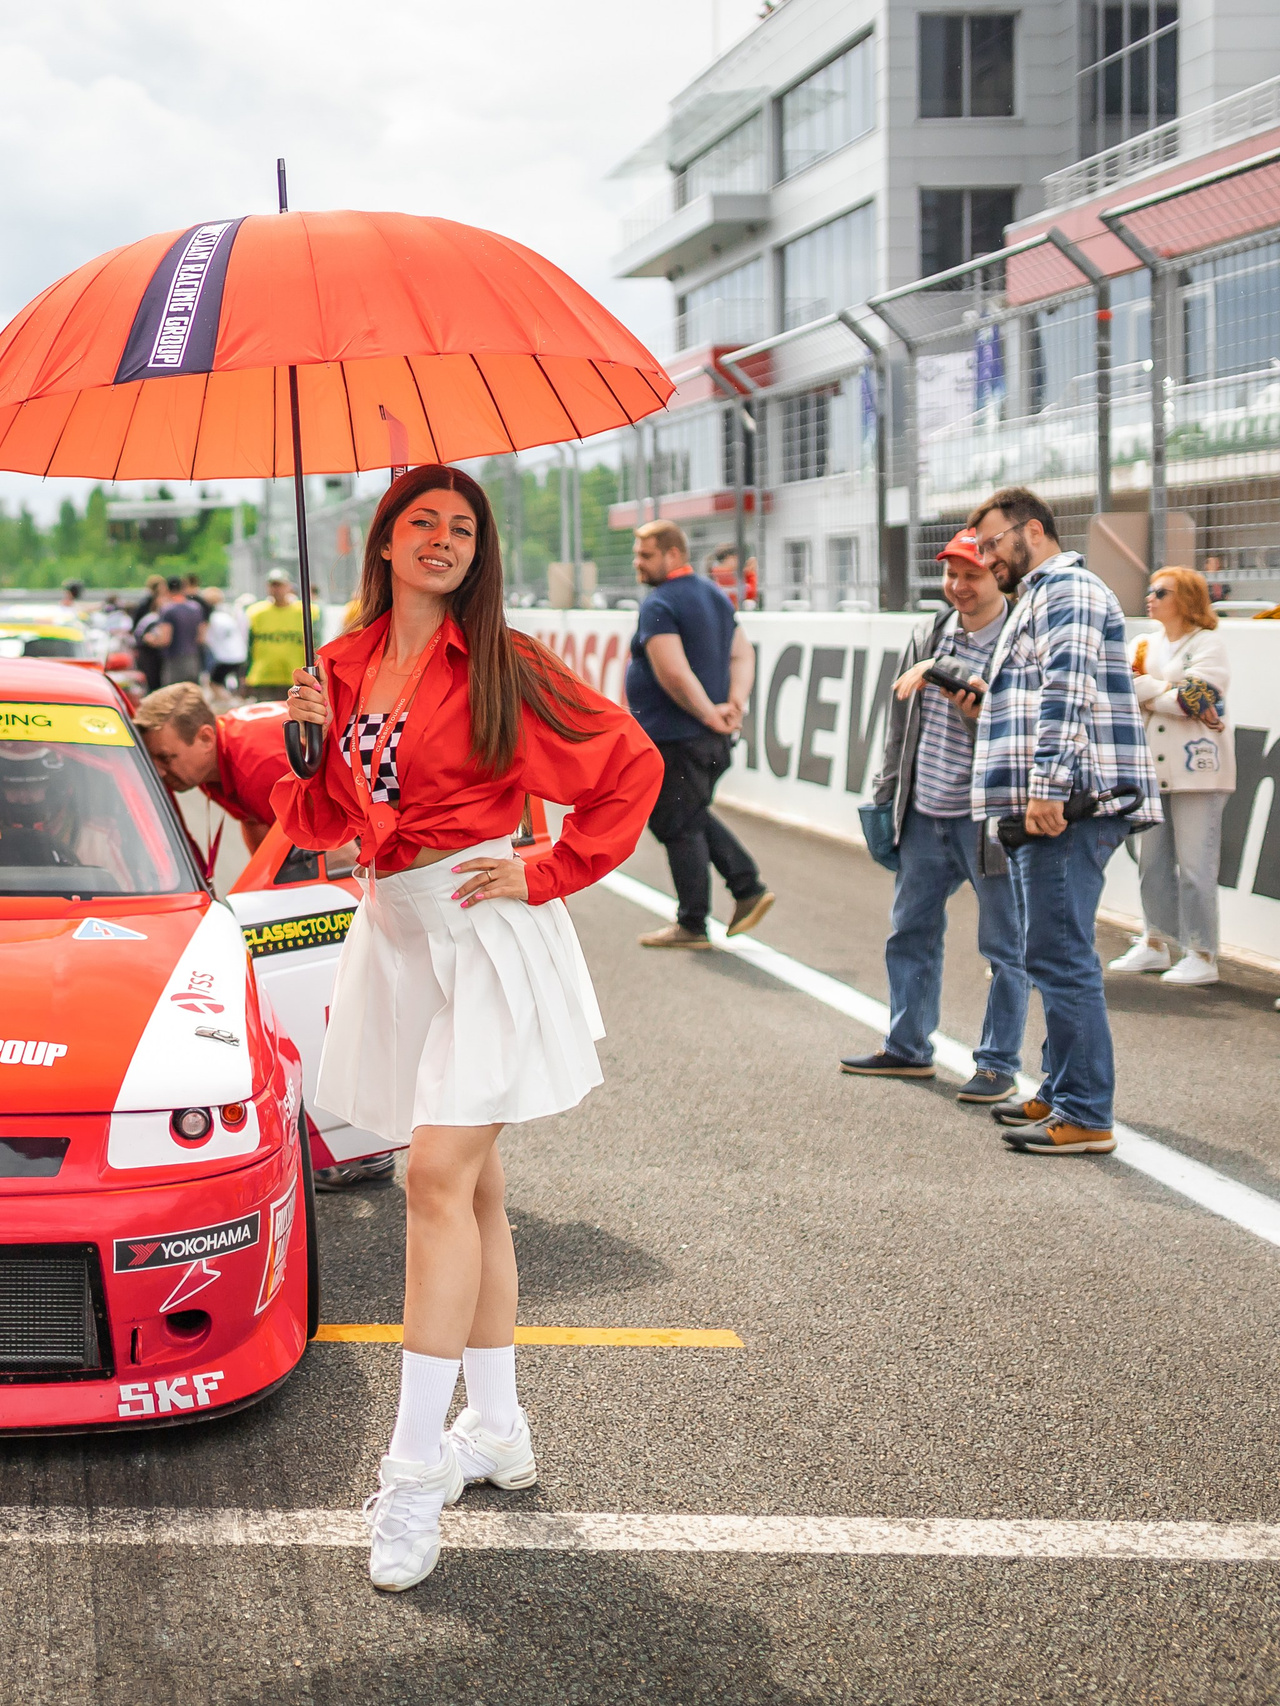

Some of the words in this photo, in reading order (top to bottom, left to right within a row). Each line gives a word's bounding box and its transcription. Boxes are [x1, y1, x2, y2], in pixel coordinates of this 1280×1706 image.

[169, 264, 206, 312] RACING
[156, 316, 189, 363] GROUP
[376, 726, 391, 752] CLASSIC
[389, 698, 405, 725] TOURING
[187, 970, 215, 994] TSS
[160, 1223, 252, 1260] YOKOHAMA
[118, 1370, 225, 1417] SKF
